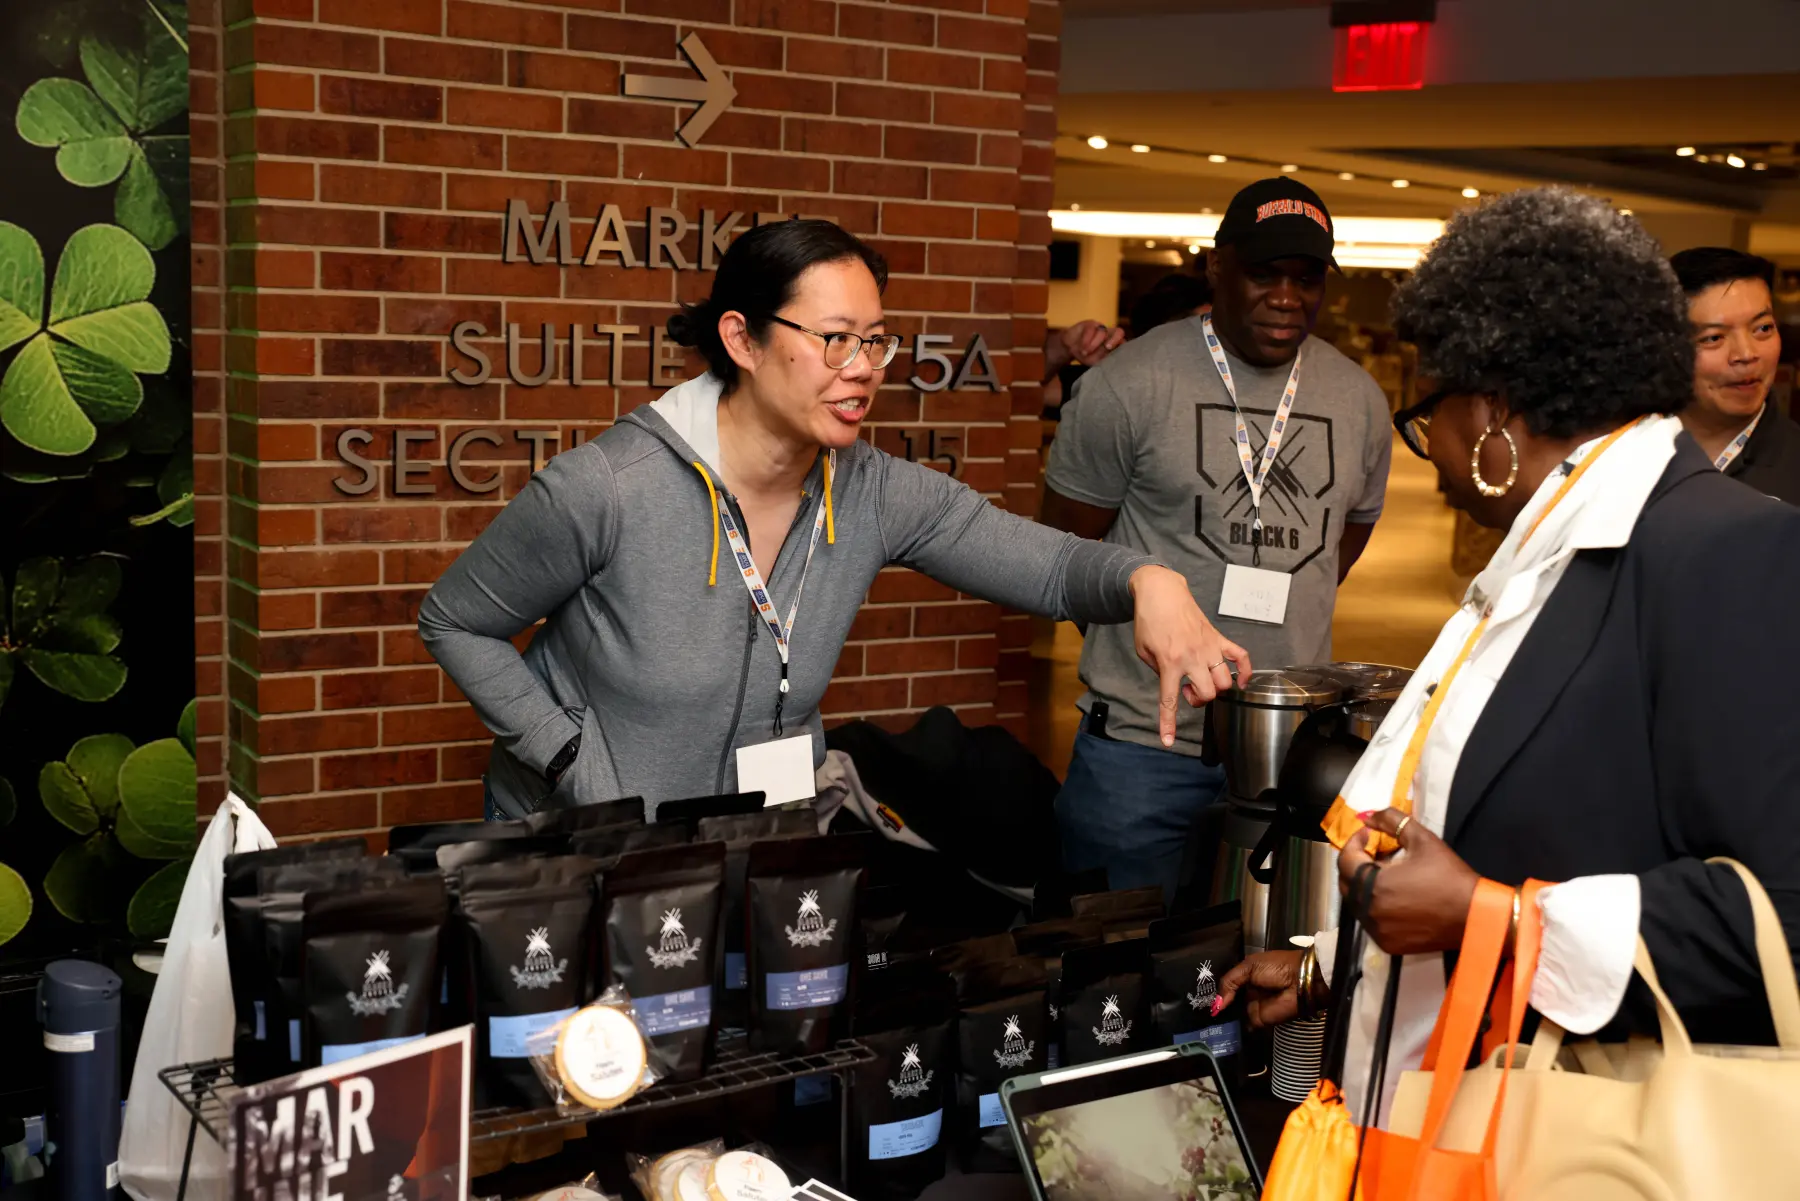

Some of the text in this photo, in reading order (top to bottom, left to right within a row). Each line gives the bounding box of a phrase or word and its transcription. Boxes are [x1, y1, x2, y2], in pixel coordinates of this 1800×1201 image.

[504, 199, 839, 271] MARK
[1256, 198, 1303, 223] BUFFALO
[450, 320, 690, 388] SUITE
[333, 428, 587, 495] SECT
[1289, 528, 1299, 550] 6
